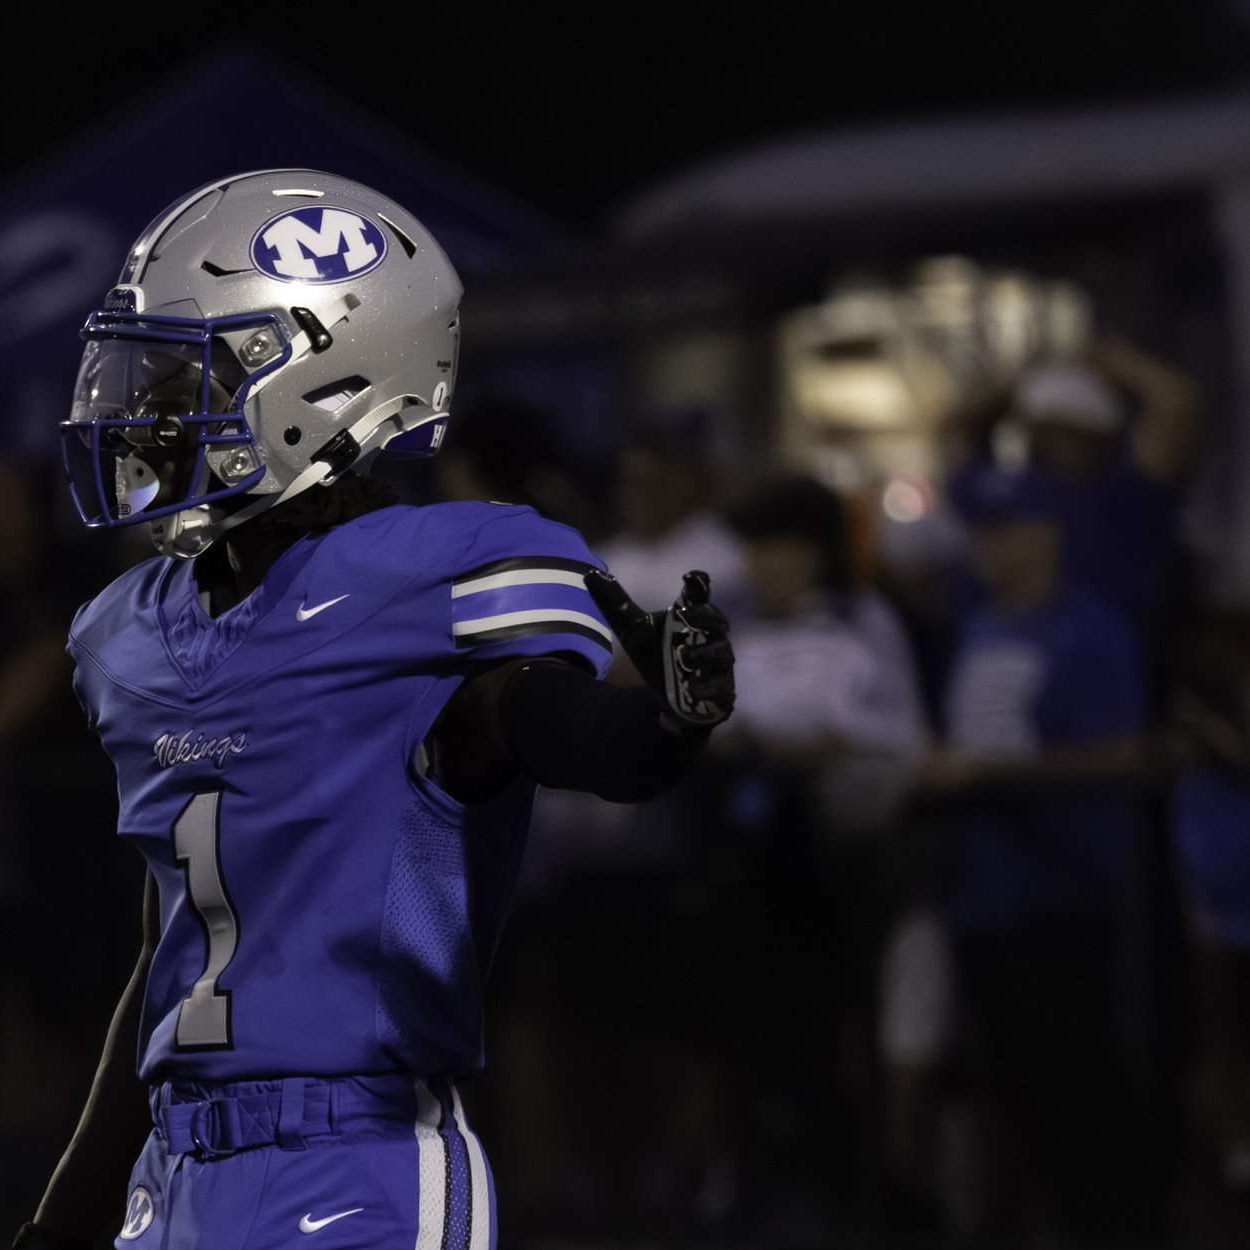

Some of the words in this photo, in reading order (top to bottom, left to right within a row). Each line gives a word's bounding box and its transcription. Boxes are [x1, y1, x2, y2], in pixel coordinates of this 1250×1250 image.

[261, 208, 378, 279] M
[153, 729, 248, 768] Vikings
[172, 788, 240, 1050] 1
